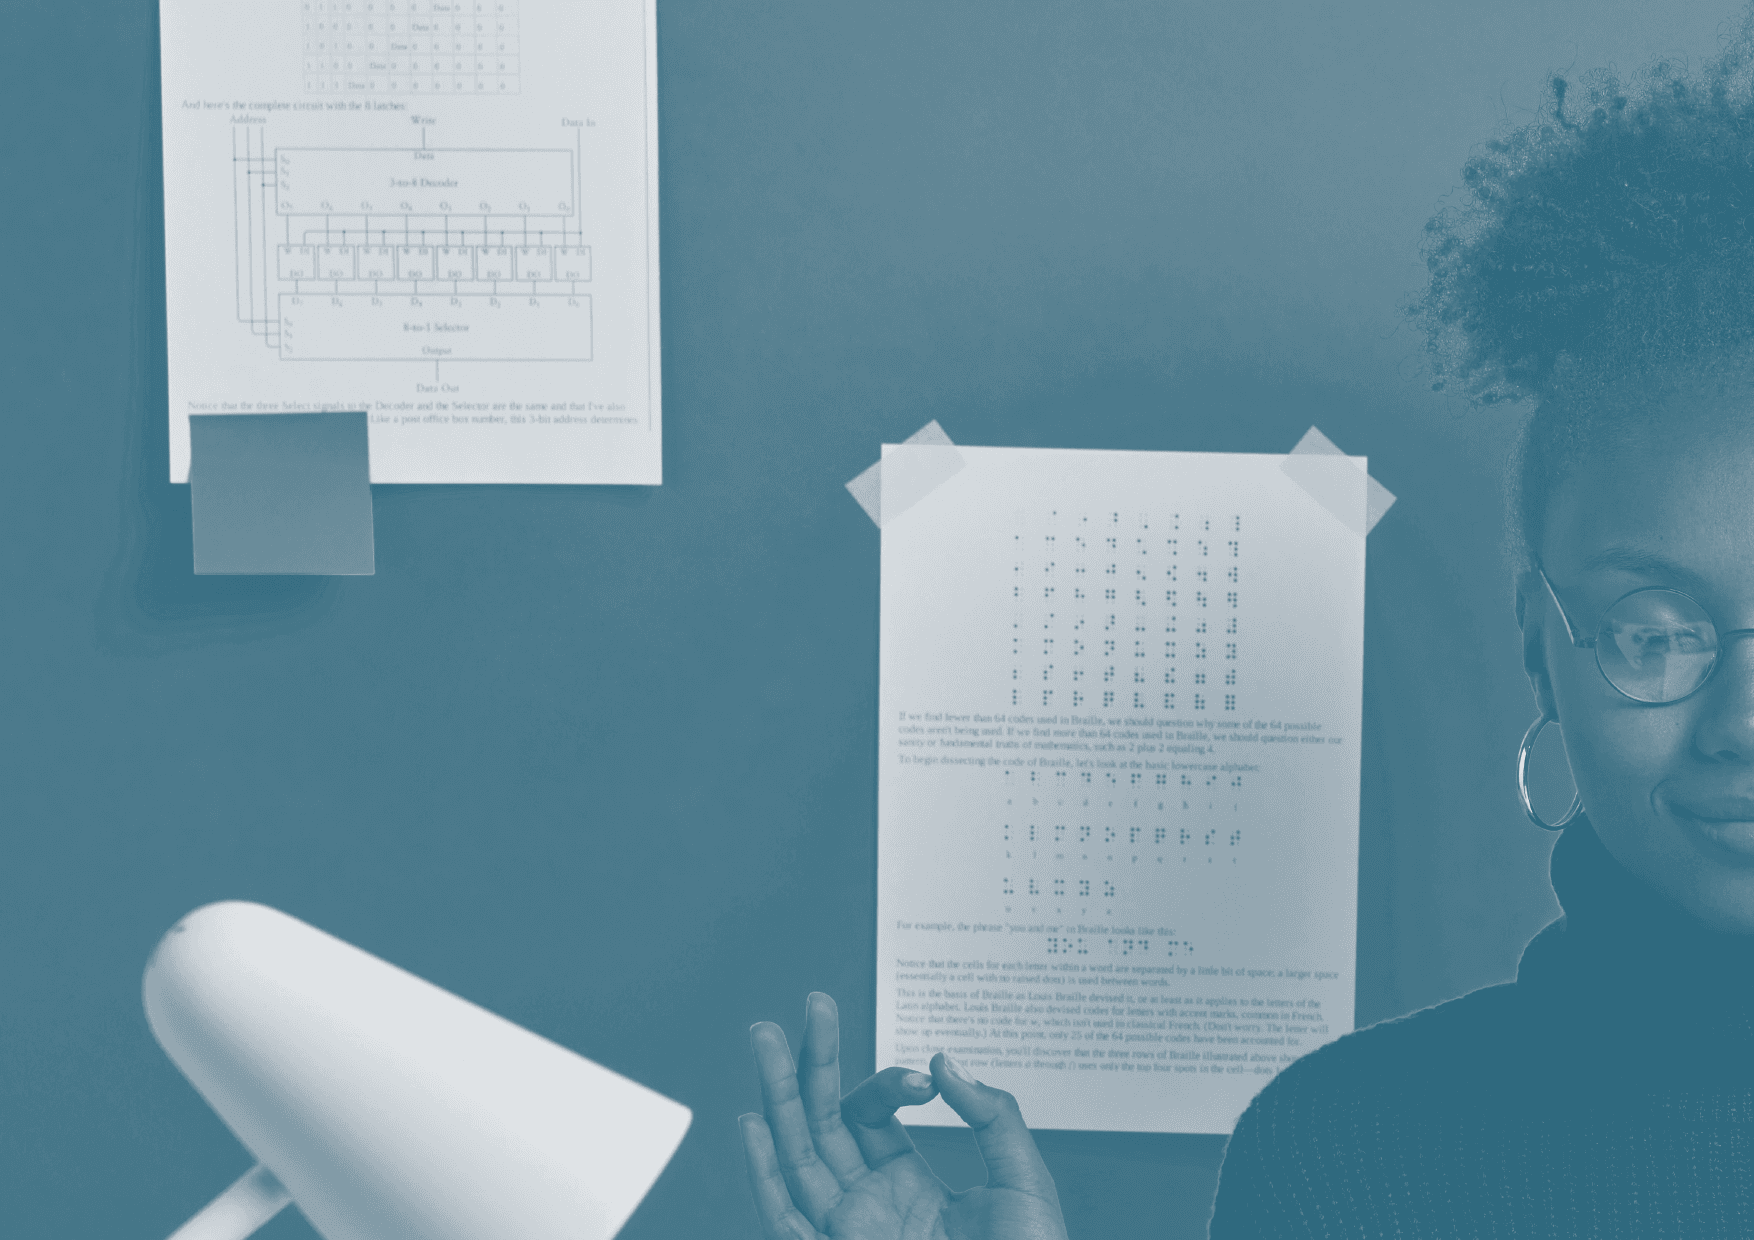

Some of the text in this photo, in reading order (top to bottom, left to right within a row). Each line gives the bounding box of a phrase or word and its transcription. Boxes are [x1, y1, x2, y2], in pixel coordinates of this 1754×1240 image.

[181, 100, 200, 111] And
[232, 100, 246, 111] the
[326, 100, 346, 111] with
[349, 100, 362, 111] the
[230, 113, 267, 124] Address
[410, 114, 436, 125] Write
[561, 117, 584, 127] Data
[420, 178, 459, 188] Decoder
[434, 323, 470, 333] Selector
[188, 400, 217, 410] Notice
[221, 400, 238, 410] that
[240, 400, 253, 410] the
[359, 401, 372, 411] the
[375, 401, 413, 411] Decoder
[417, 401, 433, 411] and
[436, 401, 449, 411] the
[452, 401, 489, 411] Selector
[509, 401, 523, 411] the
[550, 401, 567, 411] and
[569, 401, 586, 411] that
[371, 414, 390, 423] Like
[401, 414, 420, 426] post
[451, 414, 469, 424] box
[509, 414, 526, 424] this
[1255, 720, 1267, 729] the
[988, 756, 1001, 766] the
[1129, 759, 1142, 769] the
[957, 922, 971, 931] the
